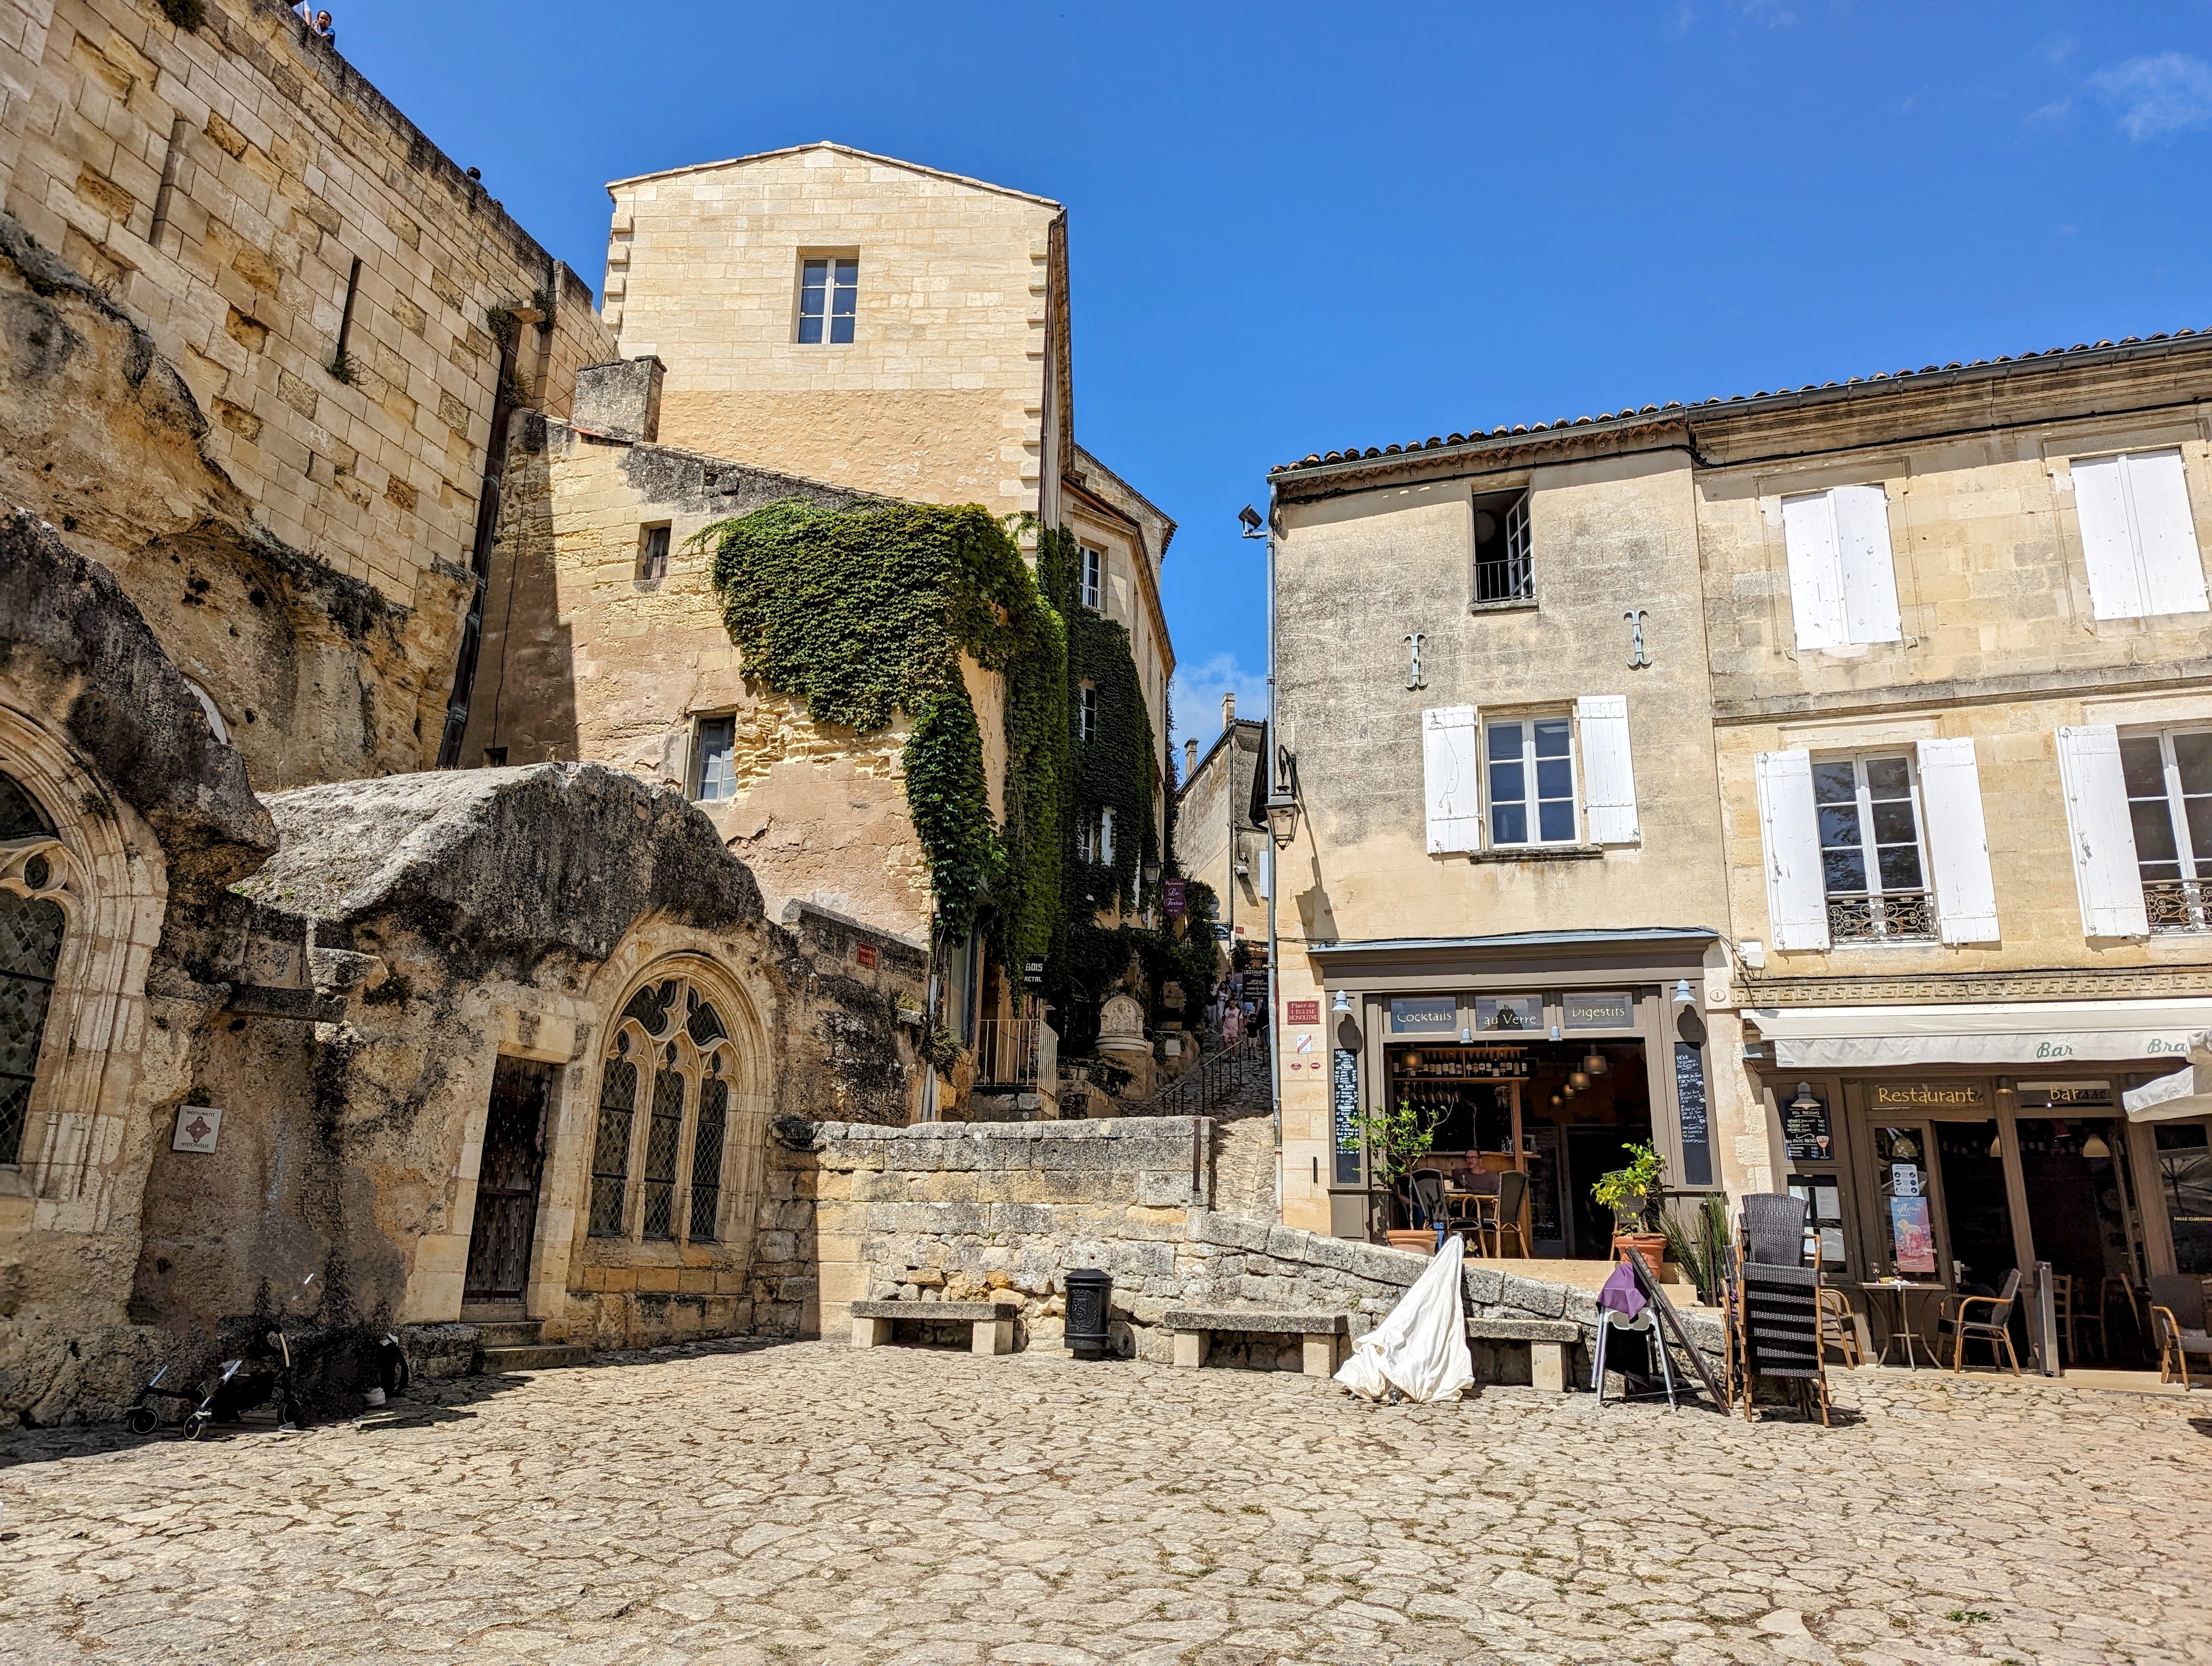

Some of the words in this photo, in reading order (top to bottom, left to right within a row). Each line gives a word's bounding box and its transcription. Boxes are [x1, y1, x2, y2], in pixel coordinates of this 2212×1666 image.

[1168, 888, 1180, 896] Le
[1163, 898, 1184, 906] Tertre
[1025, 963, 1043, 971] BOIS
[1397, 1008, 1451, 1022] Cocktails
[1484, 1016, 1497, 1026] au
[1503, 1014, 1536, 1024] Verre
[1572, 1006, 1625, 1021] Digestifs
[2036, 1042, 2074, 1059] Bar
[2147, 1039, 2187, 1054] Bra
[1879, 1087, 1975, 1104] Restaurant
[2050, 1085, 2079, 1101] Bar
